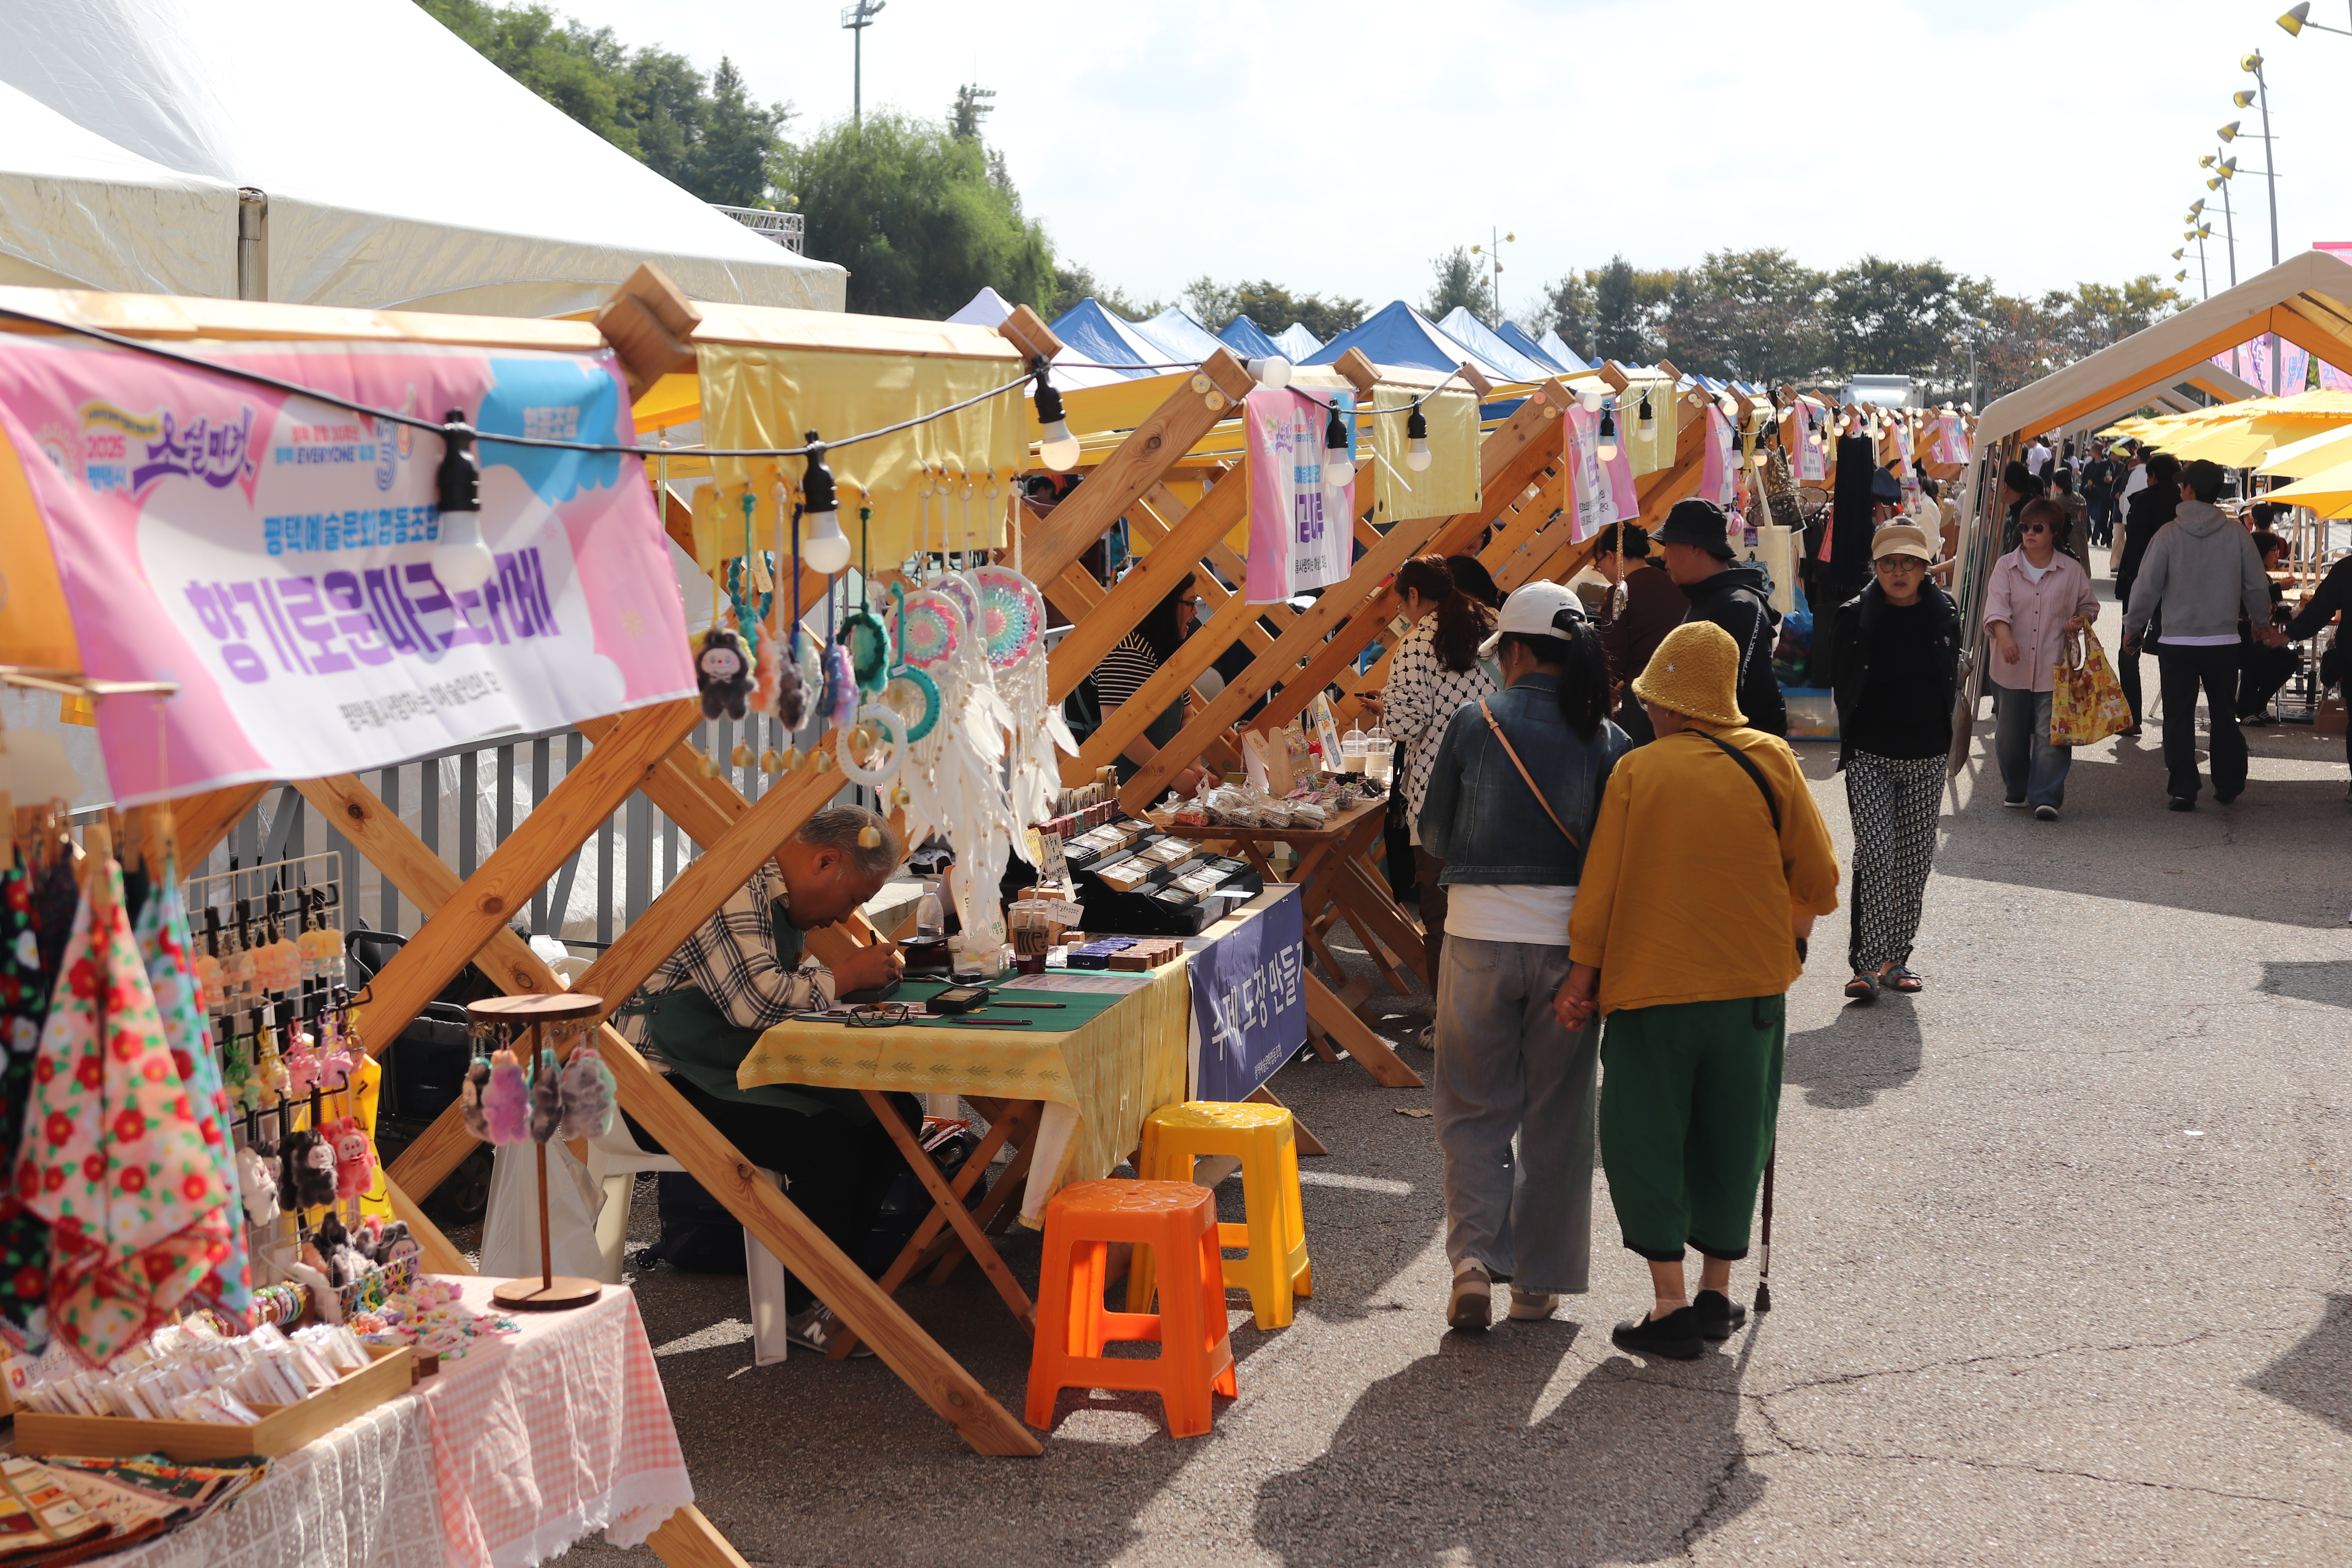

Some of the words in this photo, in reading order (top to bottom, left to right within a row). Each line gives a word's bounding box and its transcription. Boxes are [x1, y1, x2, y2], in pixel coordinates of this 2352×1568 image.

[87, 436, 126, 459] 2025
[298, 446, 356, 464] EVERYONE
[1242, 964, 1268, 1031] 도장
